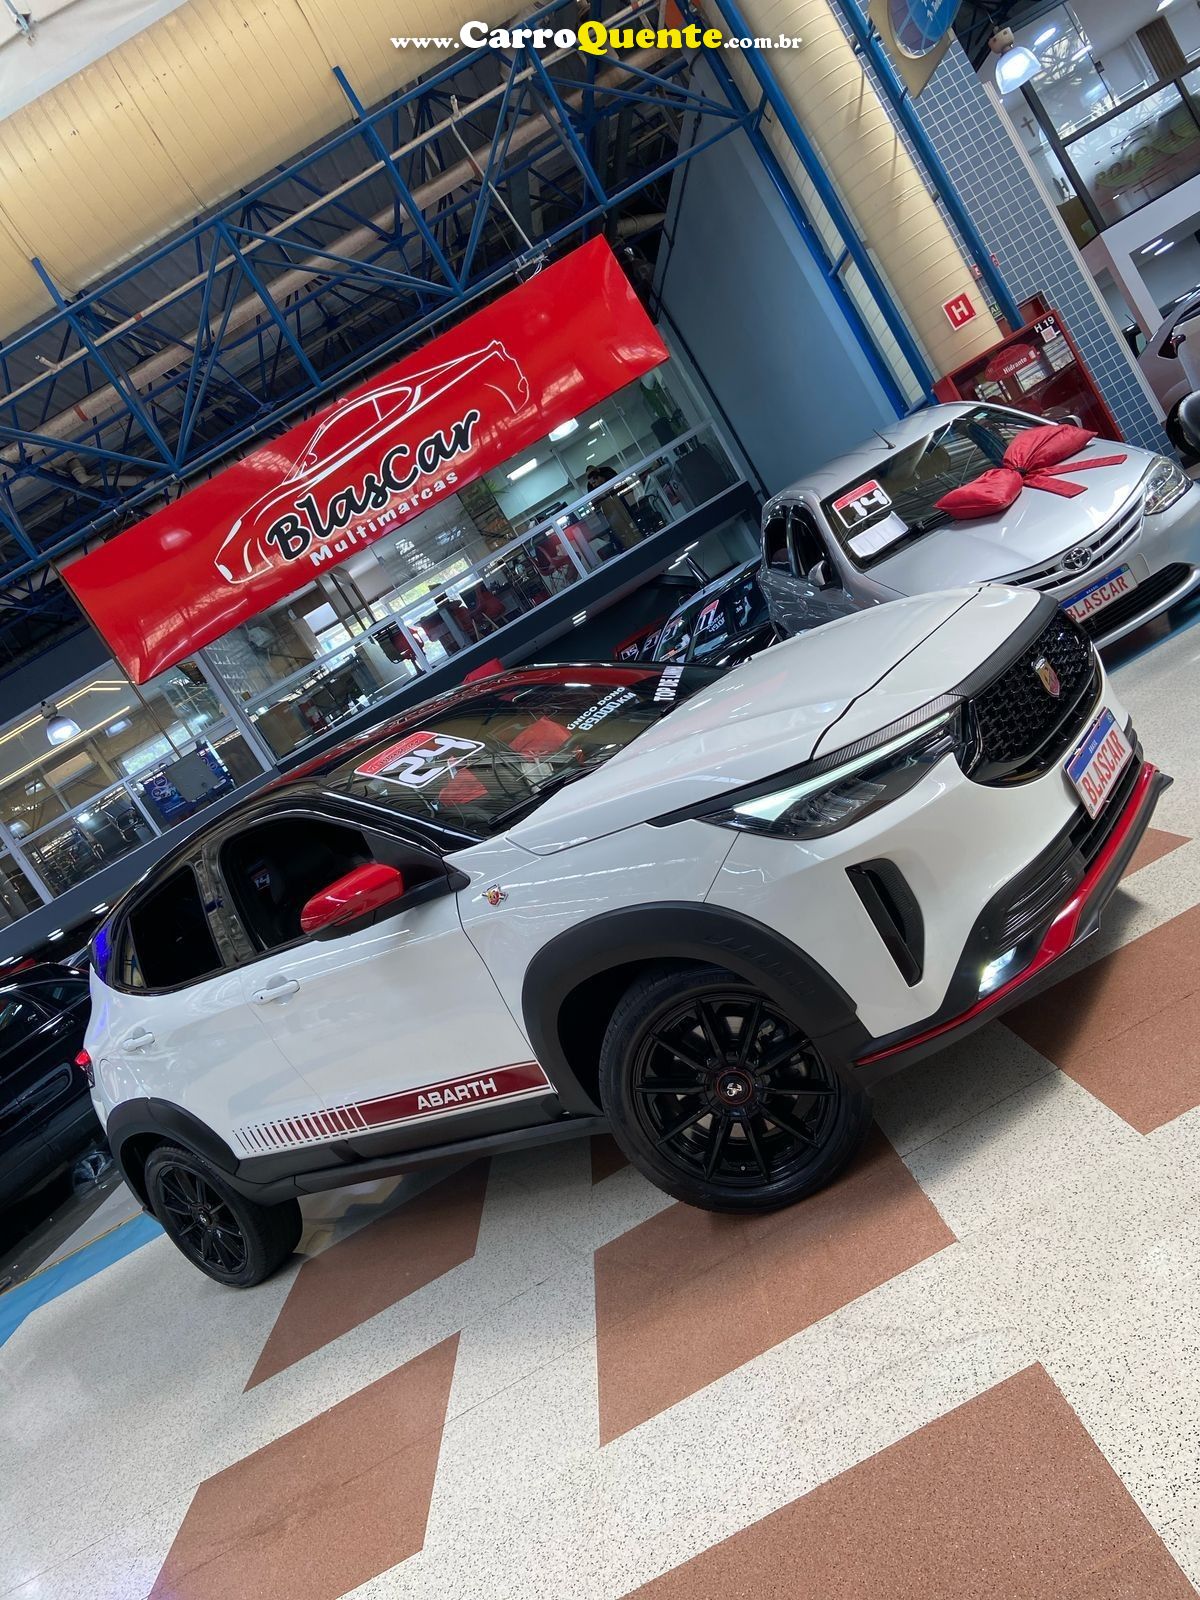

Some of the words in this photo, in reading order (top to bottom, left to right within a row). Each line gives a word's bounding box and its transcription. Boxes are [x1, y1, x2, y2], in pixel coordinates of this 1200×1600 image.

[951, 300, 969, 321] H
[1033, 322, 1043, 334] H
[1043, 316, 1055, 327] 19
[1002, 357, 1028, 375] Hidrante
[265, 409, 481, 562] BlasCar
[850, 489, 888, 517] 14
[310, 471, 459, 567] Multimarcas
[653, 687, 677, 702] TOP
[658, 678, 680, 687] DE
[597, 687, 626, 706] DONO
[381, 737, 477, 784] 24
[1081, 730, 1126, 806] BLASCAR
[417, 1077, 498, 1110] ABARTH
